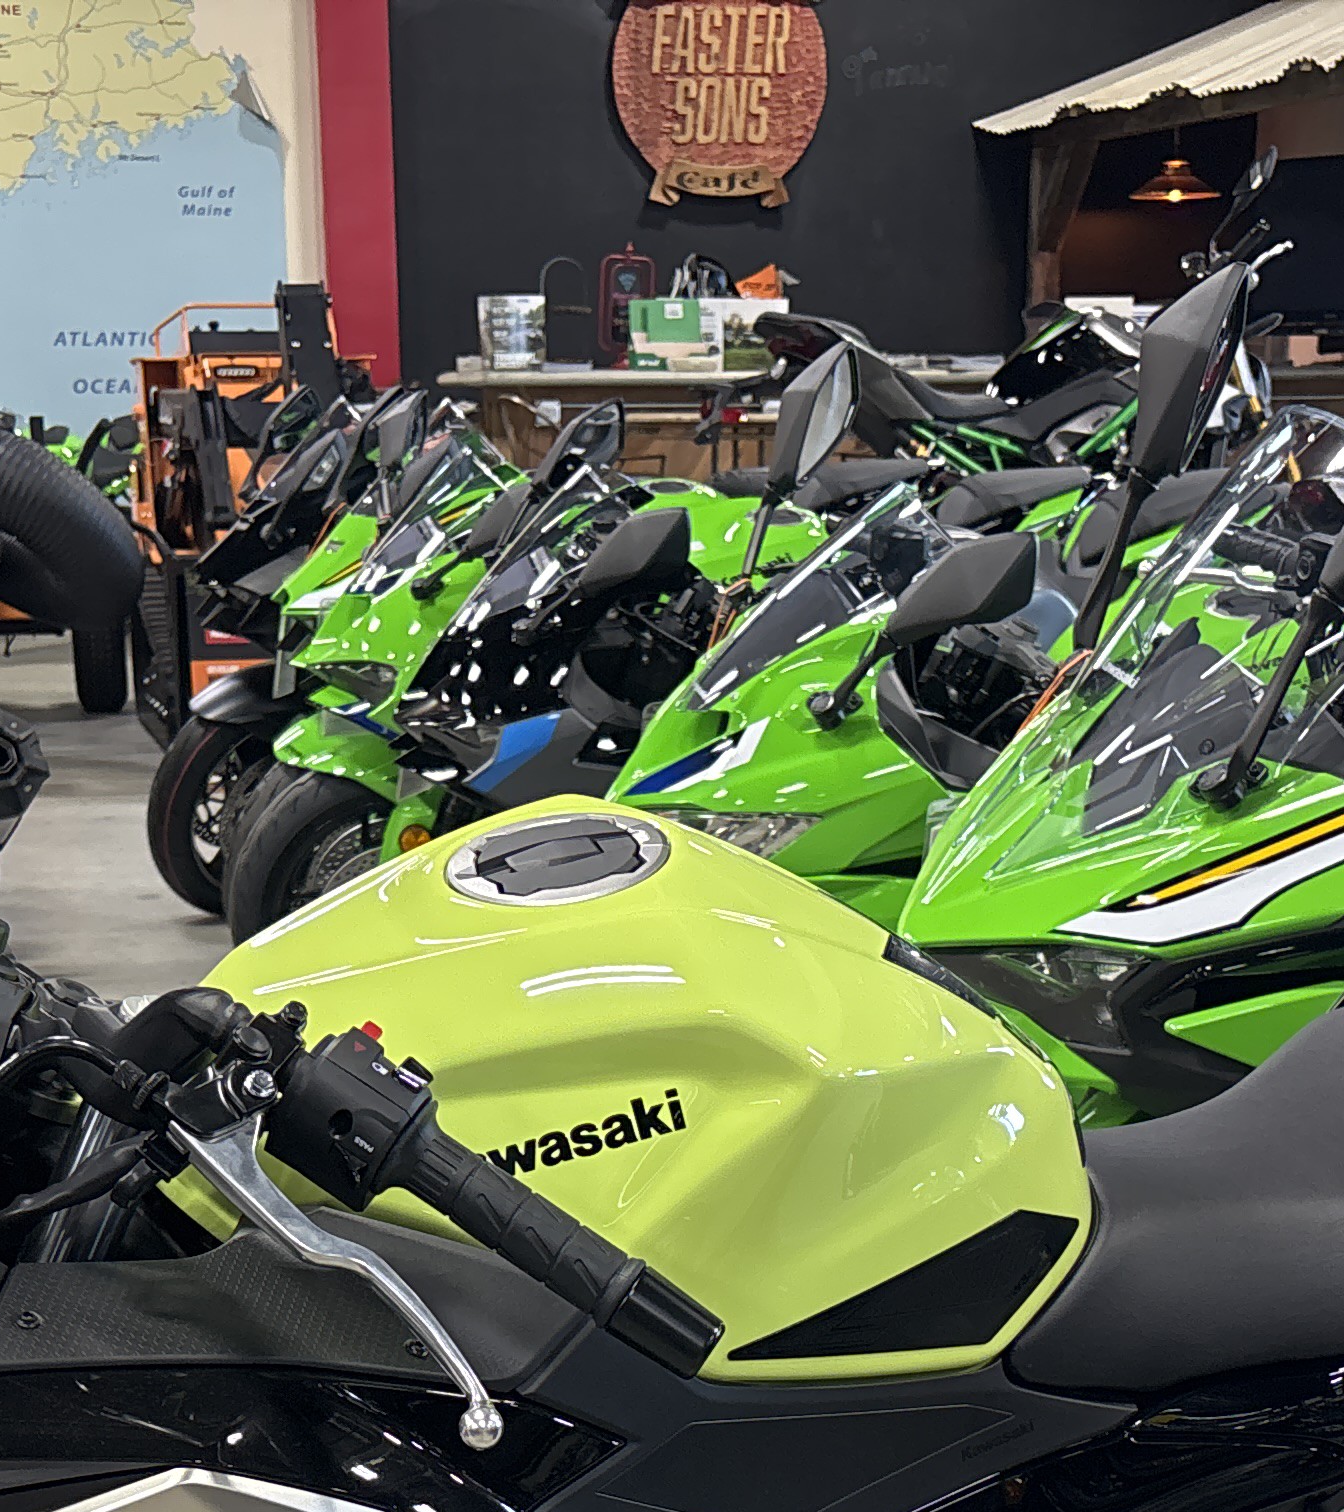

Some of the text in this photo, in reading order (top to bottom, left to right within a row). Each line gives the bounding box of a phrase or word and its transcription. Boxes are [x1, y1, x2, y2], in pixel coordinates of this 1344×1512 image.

[651, 5, 791, 74] FASTER
[671, 76, 772, 144] SONS
[177, 185, 236, 199] Gulf of
[181, 204, 233, 217] Maine
[73, 378, 138, 396] OCEA
[476, 1087, 687, 1176] wasaki
